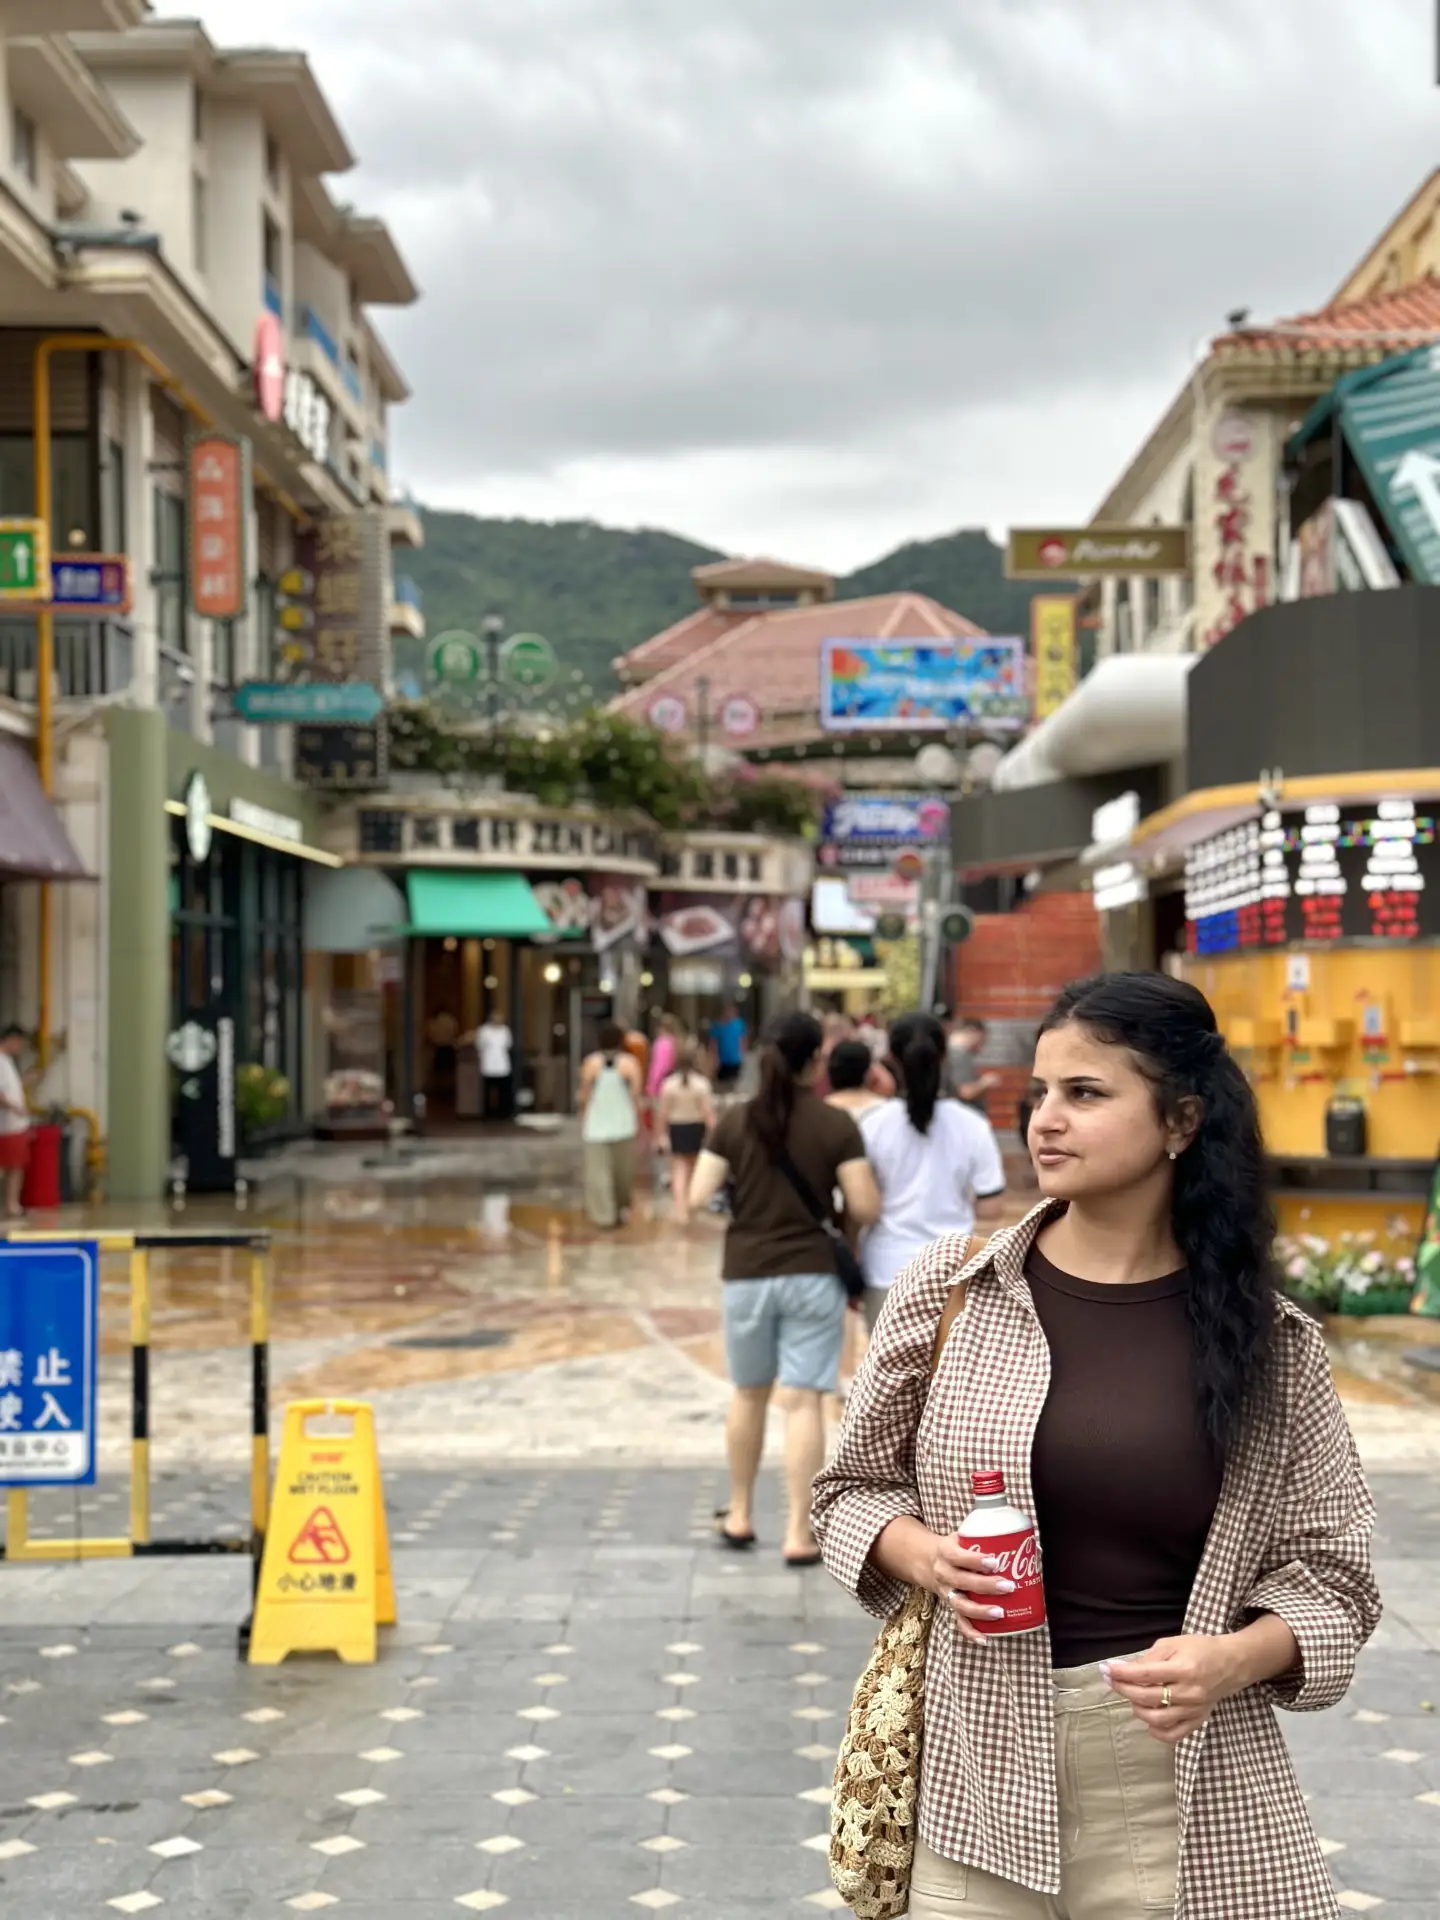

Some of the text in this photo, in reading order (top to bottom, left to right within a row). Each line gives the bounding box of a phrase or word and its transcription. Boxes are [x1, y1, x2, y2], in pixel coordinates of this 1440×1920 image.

[297, 1472, 352, 1482] CAUTION
[289, 1484, 359, 1495] WET FLOOR
